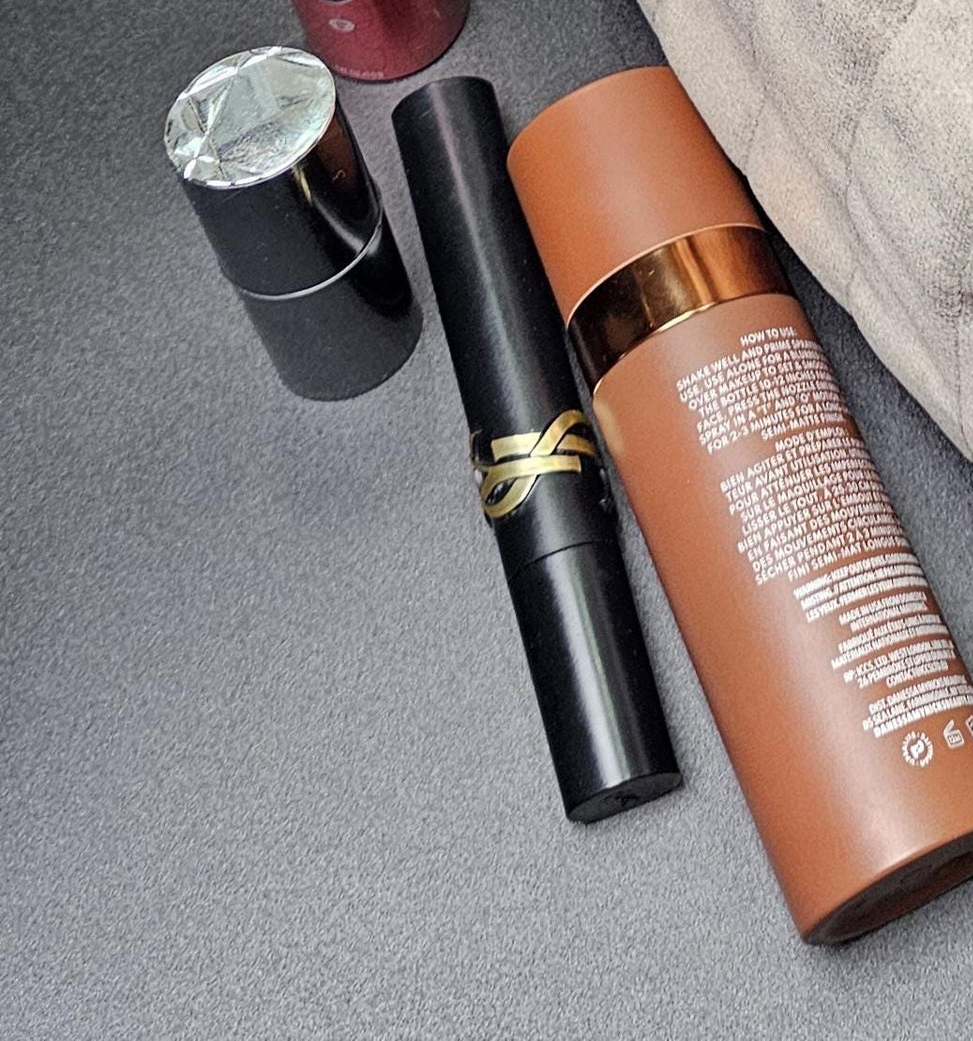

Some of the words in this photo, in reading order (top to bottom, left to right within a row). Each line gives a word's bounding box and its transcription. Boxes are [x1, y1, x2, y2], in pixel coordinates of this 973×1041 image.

[740, 332, 764, 346] HOW
[765, 328, 779, 338] TO
[779, 326, 796, 337] USE:
[677, 366, 710, 390] SHAKE
[711, 355, 740, 372] WELL
[741, 346, 763, 361] AND
[763, 339, 791, 353] PRIME
[688, 389, 717, 409] OVER
[718, 370, 760, 394] MAKEUP
[762, 365, 776, 377] TO
[777, 361, 793, 373] SET
[794, 360, 802, 370] &
[704, 371, 724, 388] USE
[726, 358, 761, 379] ALONE
[762, 352, 782, 366] FOR
[783, 351, 790, 361] A
[698, 399, 719, 417] THE
[720, 383, 758, 407] BOTTLE
[759, 375, 785, 390] 10-12
[785, 370, 815, 384] INCHES
[728, 395, 759, 416] PRESS
[759, 388, 780, 402] THE
[781, 381, 815, 397] NOZZLE
[699, 420, 730, 444] SPRAY
[733, 413, 746, 426] IN
[748, 409, 756, 421] A
[775, 396, 795, 411] AND
[707, 435, 729, 453] FOR
[729, 425, 749, 442] 2-3
[750, 408, 794, 432] MINUTES
[795, 403, 814, 416] FOR
[815, 402, 822, 412] A
[761, 414, 819, 440] SEMI-MATTE
[775, 433, 805, 452] MODE
[720, 472, 744, 492] BIEN
[747, 454, 784, 478] AGITER
[785, 447, 797, 461] ET
[799, 437, 841, 455] PRÉPARER
[726, 481, 753, 501] TEUR
[754, 464, 788, 487] AVANT
[729, 492, 759, 514] POUR
[760, 469, 812, 498] ATTÉNUER
[813, 462, 831, 476] LES
[740, 504, 762, 521] SUR
[762, 496, 776, 510] LE
[777, 473, 841, 503] MAQUILLAGE
[842, 470, 864, 481] POUR
[742, 510, 776, 535] LISSER
[777, 502, 791, 517] LE
[831, 481, 858, 496] 25-30
[858, 480, 870, 491] CM
[738, 531, 762, 552] BIEN
[764, 509, 810, 536] APPUYER
[811, 500, 832, 516] SUR
[832, 492, 872, 509] L'EMBOUT
[747, 545, 763, 561] EN
[763, 523, 806, 552] FAISANT
[809, 514, 830, 530] DES
[752, 553, 773, 572] DES
[774, 522, 846, 560] MOUVEMENTS
[756, 556, 795, 584] SÉCHER
[796, 535, 844, 563] PENDANT
[846, 532, 855, 543] 2
[862, 527, 870, 539] 3
[787, 563, 809, 581] FINI
[811, 542, 861, 570] SEMI-MAT
[862, 536, 895, 551] LONGUE
[831, 566, 848, 581] KEEP
[847, 561, 863, 575] OUT
[861, 558, 871, 570] OF
[805, 607, 820, 622] LES
[839, 587, 868, 605] FERMER
[867, 583, 879, 596] LES
[839, 608, 861, 624] MADE
[860, 605, 869, 615] IN
[867, 600, 883, 613] USA
[838, 629, 874, 653] FABRIQUÉ
[873, 624, 888, 637] AUX
[857, 675, 869, 689] 26
[872, 711, 888, 725] SEA
